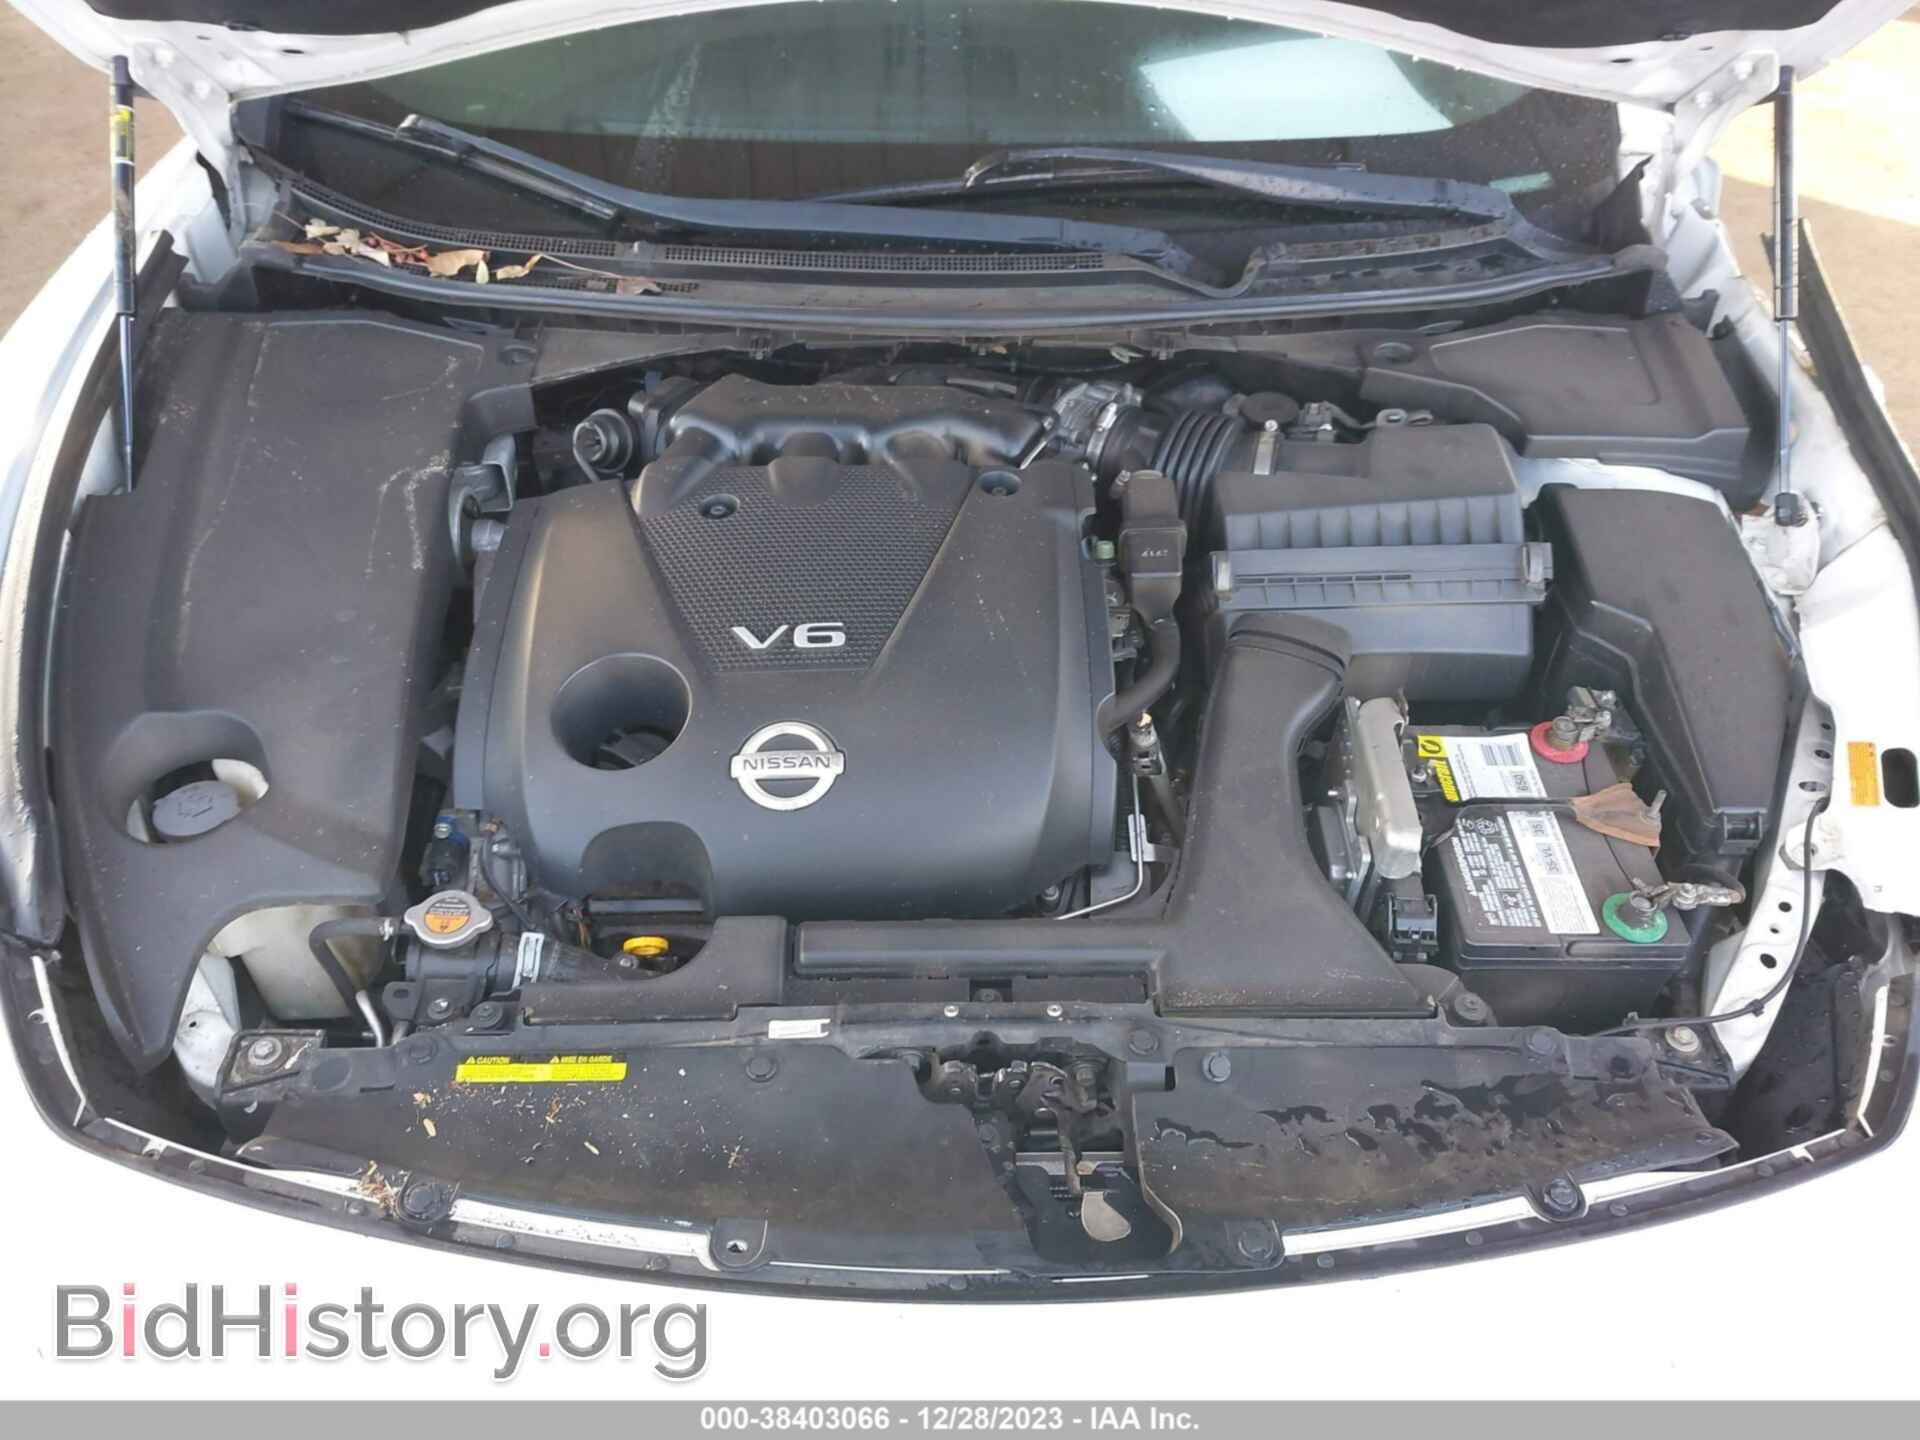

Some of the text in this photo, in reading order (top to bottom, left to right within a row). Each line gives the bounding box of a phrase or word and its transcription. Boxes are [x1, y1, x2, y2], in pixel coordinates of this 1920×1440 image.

[732, 622, 846, 649] V6
[743, 756, 831, 771] NISSAN
[476, 1055, 510, 1065] CAUTION
